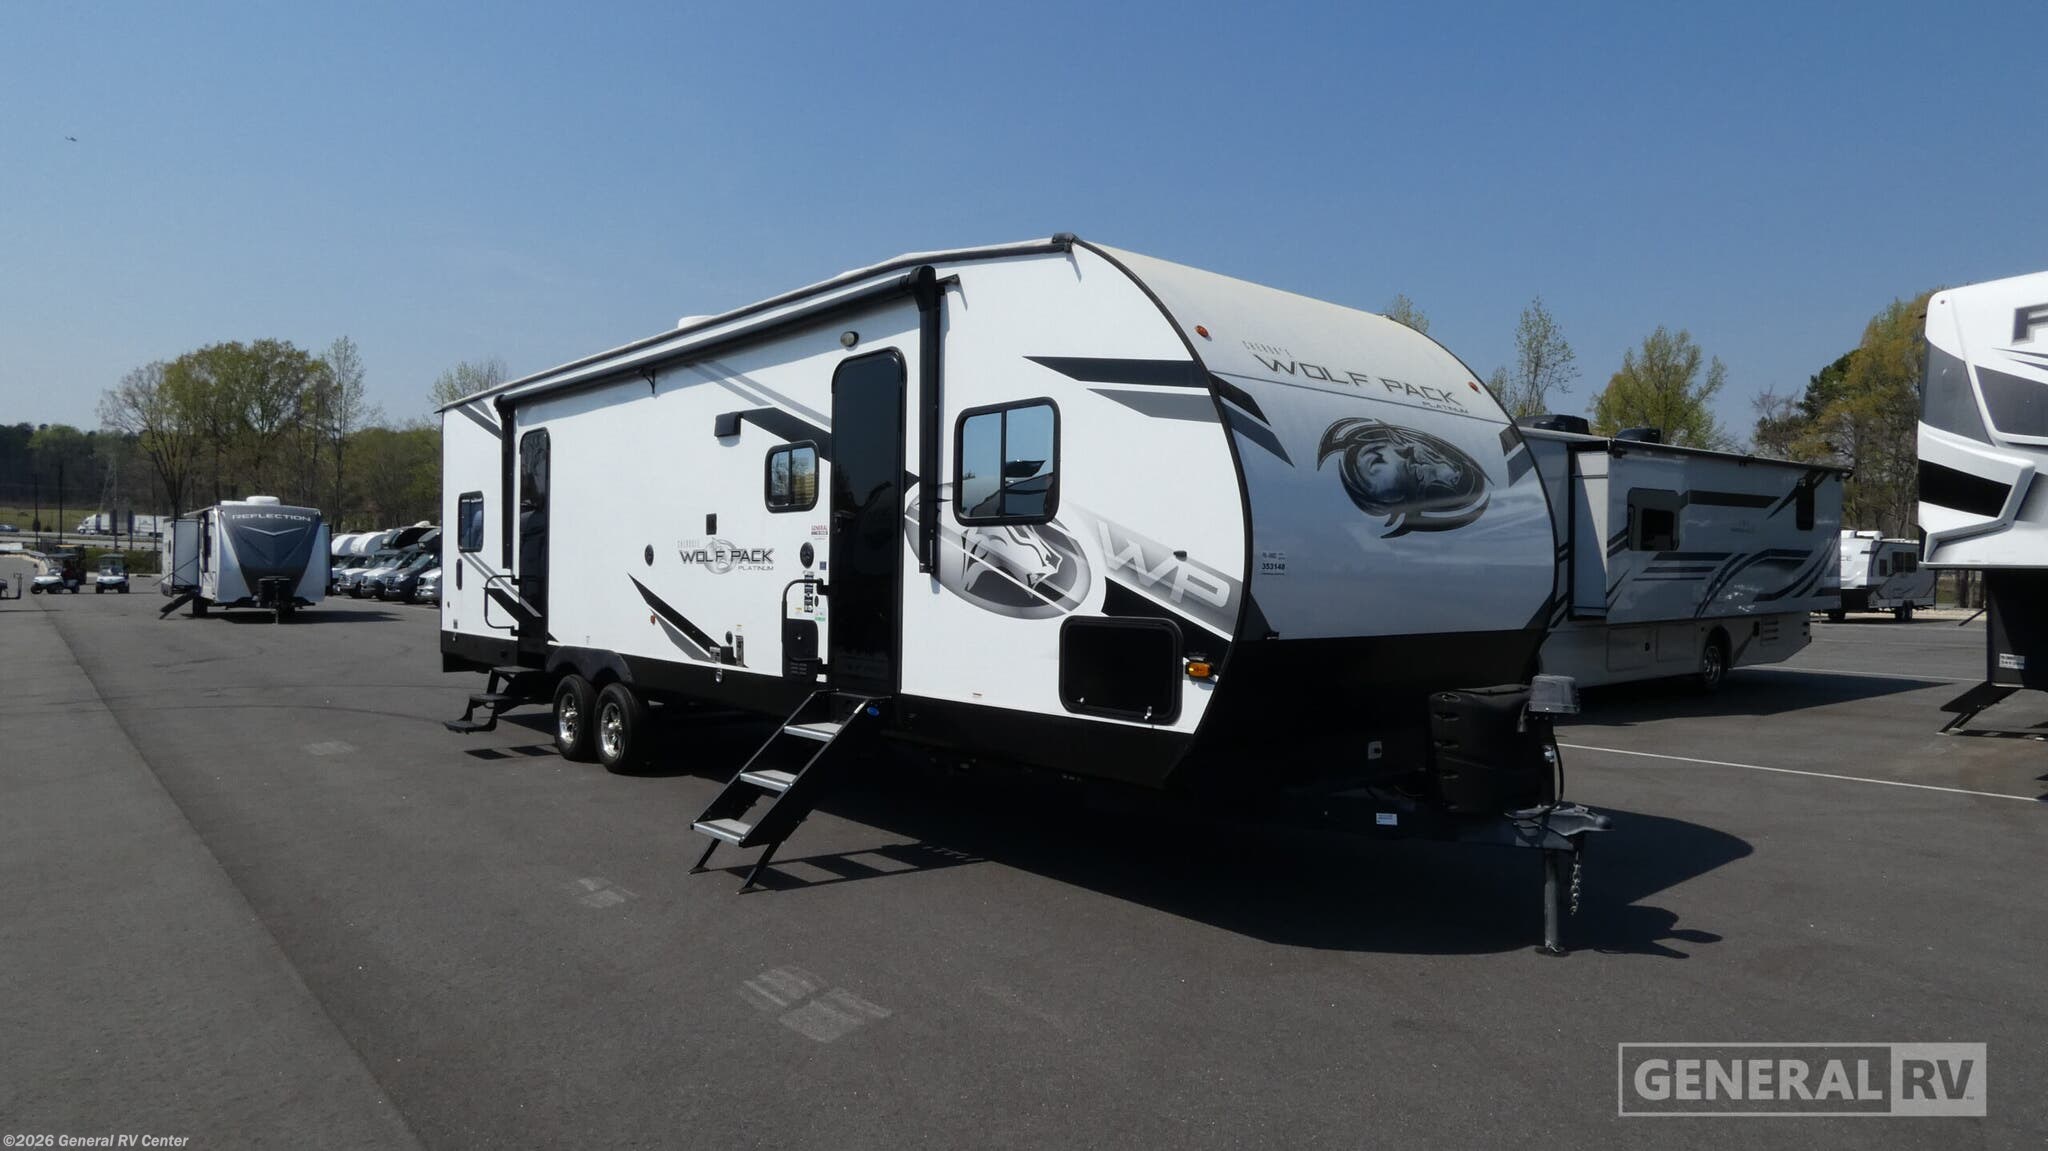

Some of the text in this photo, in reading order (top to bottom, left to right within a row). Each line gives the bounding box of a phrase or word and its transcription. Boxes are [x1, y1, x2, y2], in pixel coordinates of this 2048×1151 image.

[1252, 353, 1463, 406] WOLF PACK
[232, 513, 312, 522] REFLECTION
[679, 548, 775, 564] WOLF PACK
[1096, 520, 1231, 608] WP
